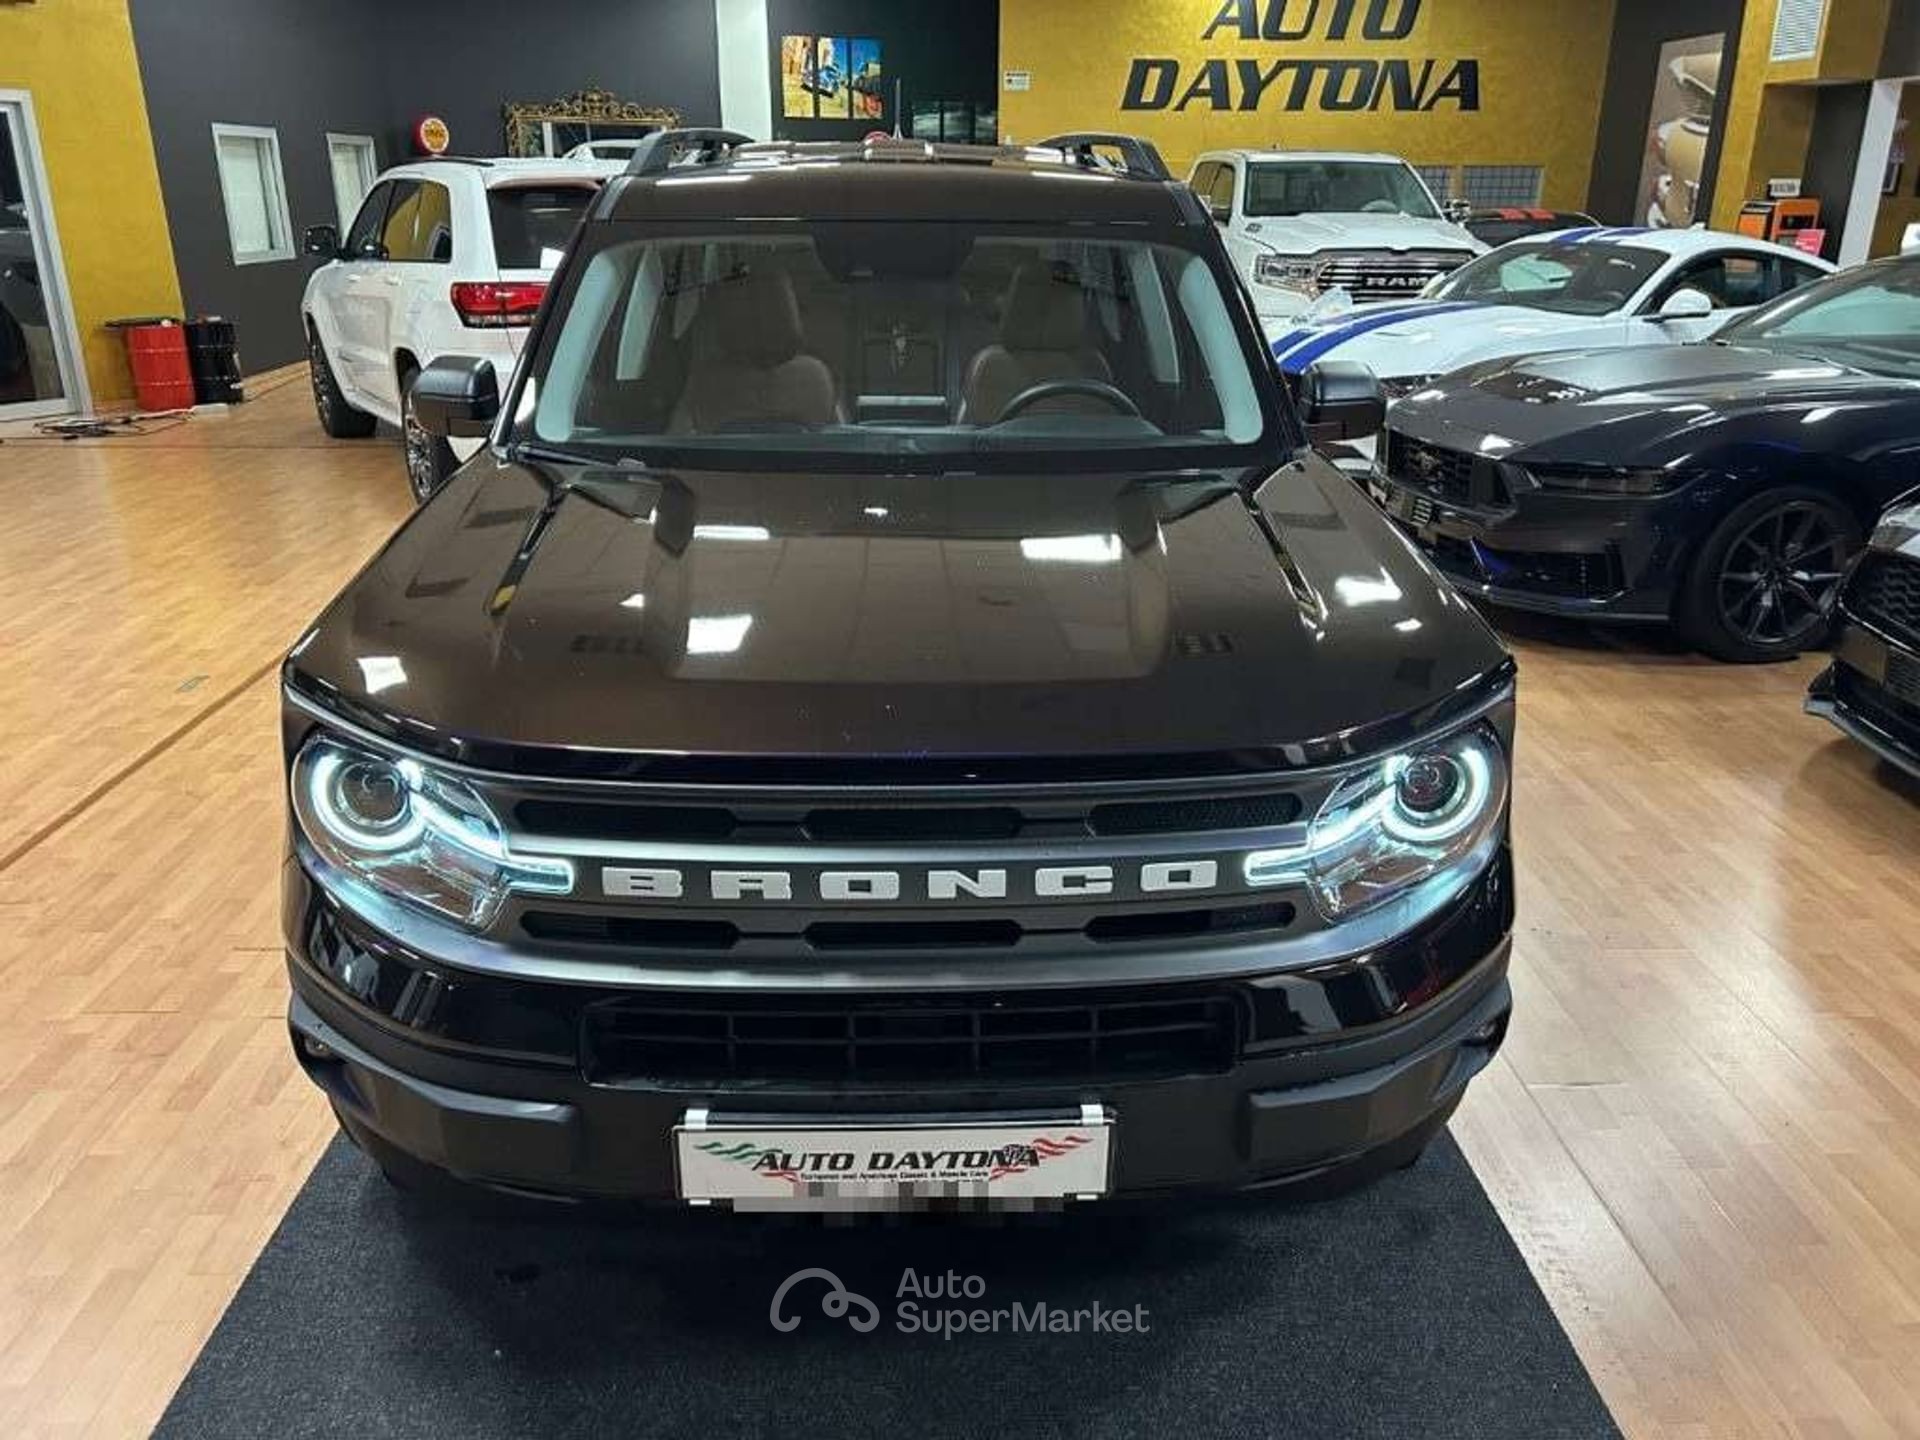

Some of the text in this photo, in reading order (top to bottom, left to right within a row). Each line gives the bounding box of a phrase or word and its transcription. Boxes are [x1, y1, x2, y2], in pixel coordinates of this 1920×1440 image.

[1202, 0, 1420, 41] AUTO
[1120, 58, 1481, 112] DAYTONA
[1366, 276, 1428, 287] RAM
[601, 860, 1218, 900] BRONCO
[751, 1149, 1040, 1171] AUTO DAYTONA
